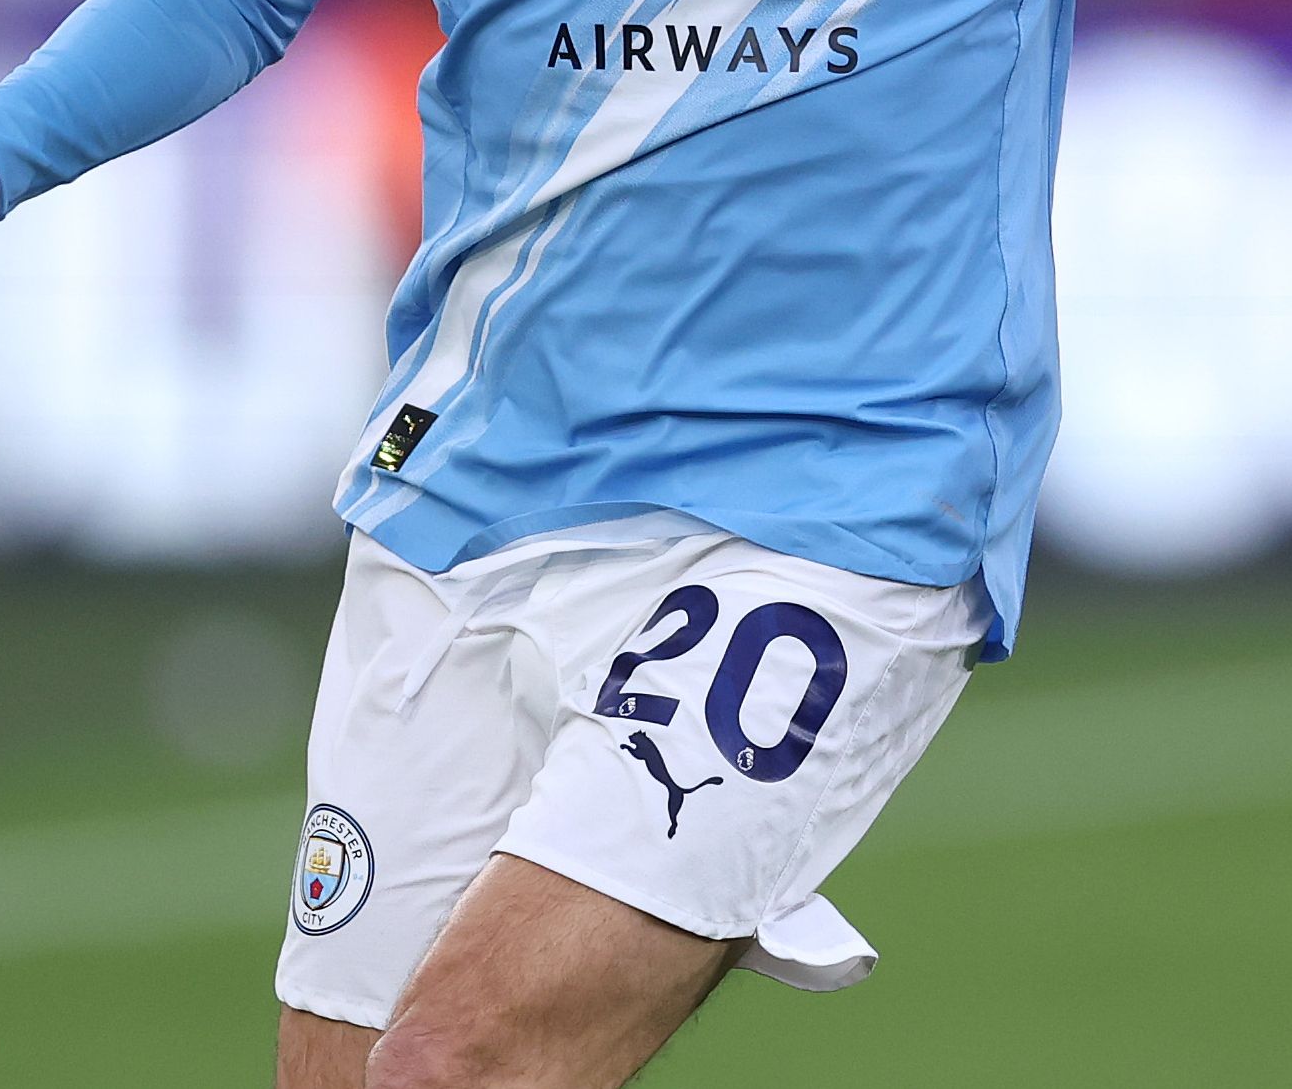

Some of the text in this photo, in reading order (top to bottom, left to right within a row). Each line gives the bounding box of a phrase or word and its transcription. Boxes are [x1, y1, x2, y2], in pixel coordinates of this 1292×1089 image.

[547, 22, 859, 74] AIRWAYS
[592, 584, 848, 783] 20
[302, 912, 325, 926] CITY
